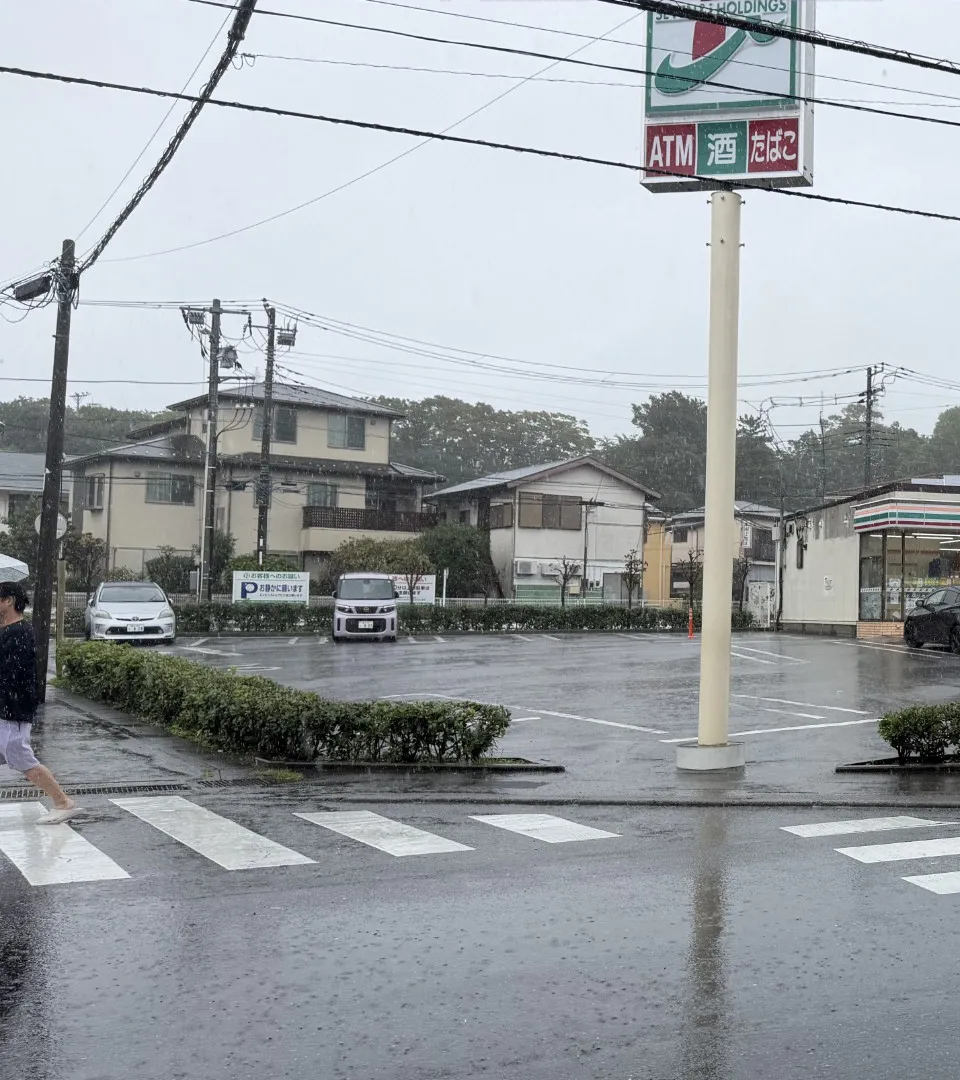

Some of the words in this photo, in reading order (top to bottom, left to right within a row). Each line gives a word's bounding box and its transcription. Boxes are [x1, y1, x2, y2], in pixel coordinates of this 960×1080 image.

[717, 0, 787, 16] HOLDINGS
[650, 134, 693, 167] ATM
[707, 132, 738, 166] 酒
[750, 128, 797, 163] たばこ
[240, 581, 258, 599] P
